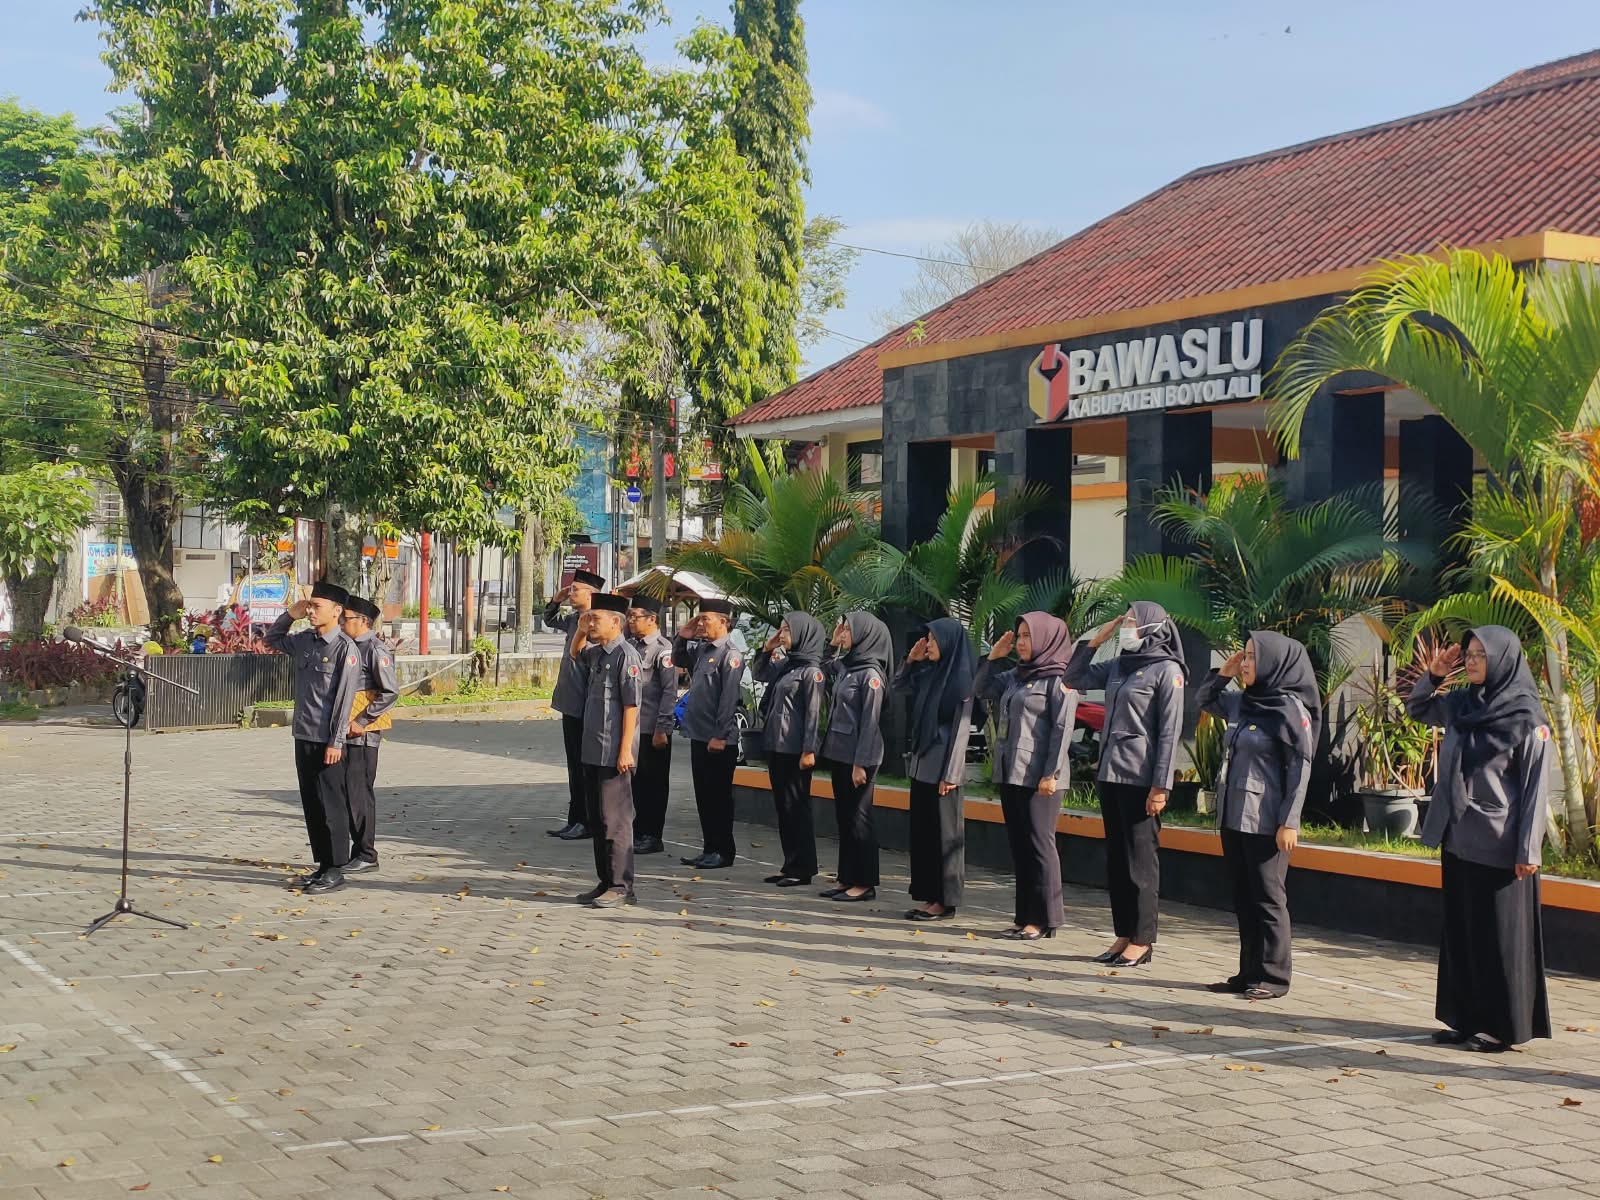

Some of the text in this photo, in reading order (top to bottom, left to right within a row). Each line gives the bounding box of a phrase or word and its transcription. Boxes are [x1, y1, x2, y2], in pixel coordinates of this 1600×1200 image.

[1069, 318, 1263, 395] BAWASLU
[1068, 374, 1261, 420] KABUPATEN BOYOLALI
